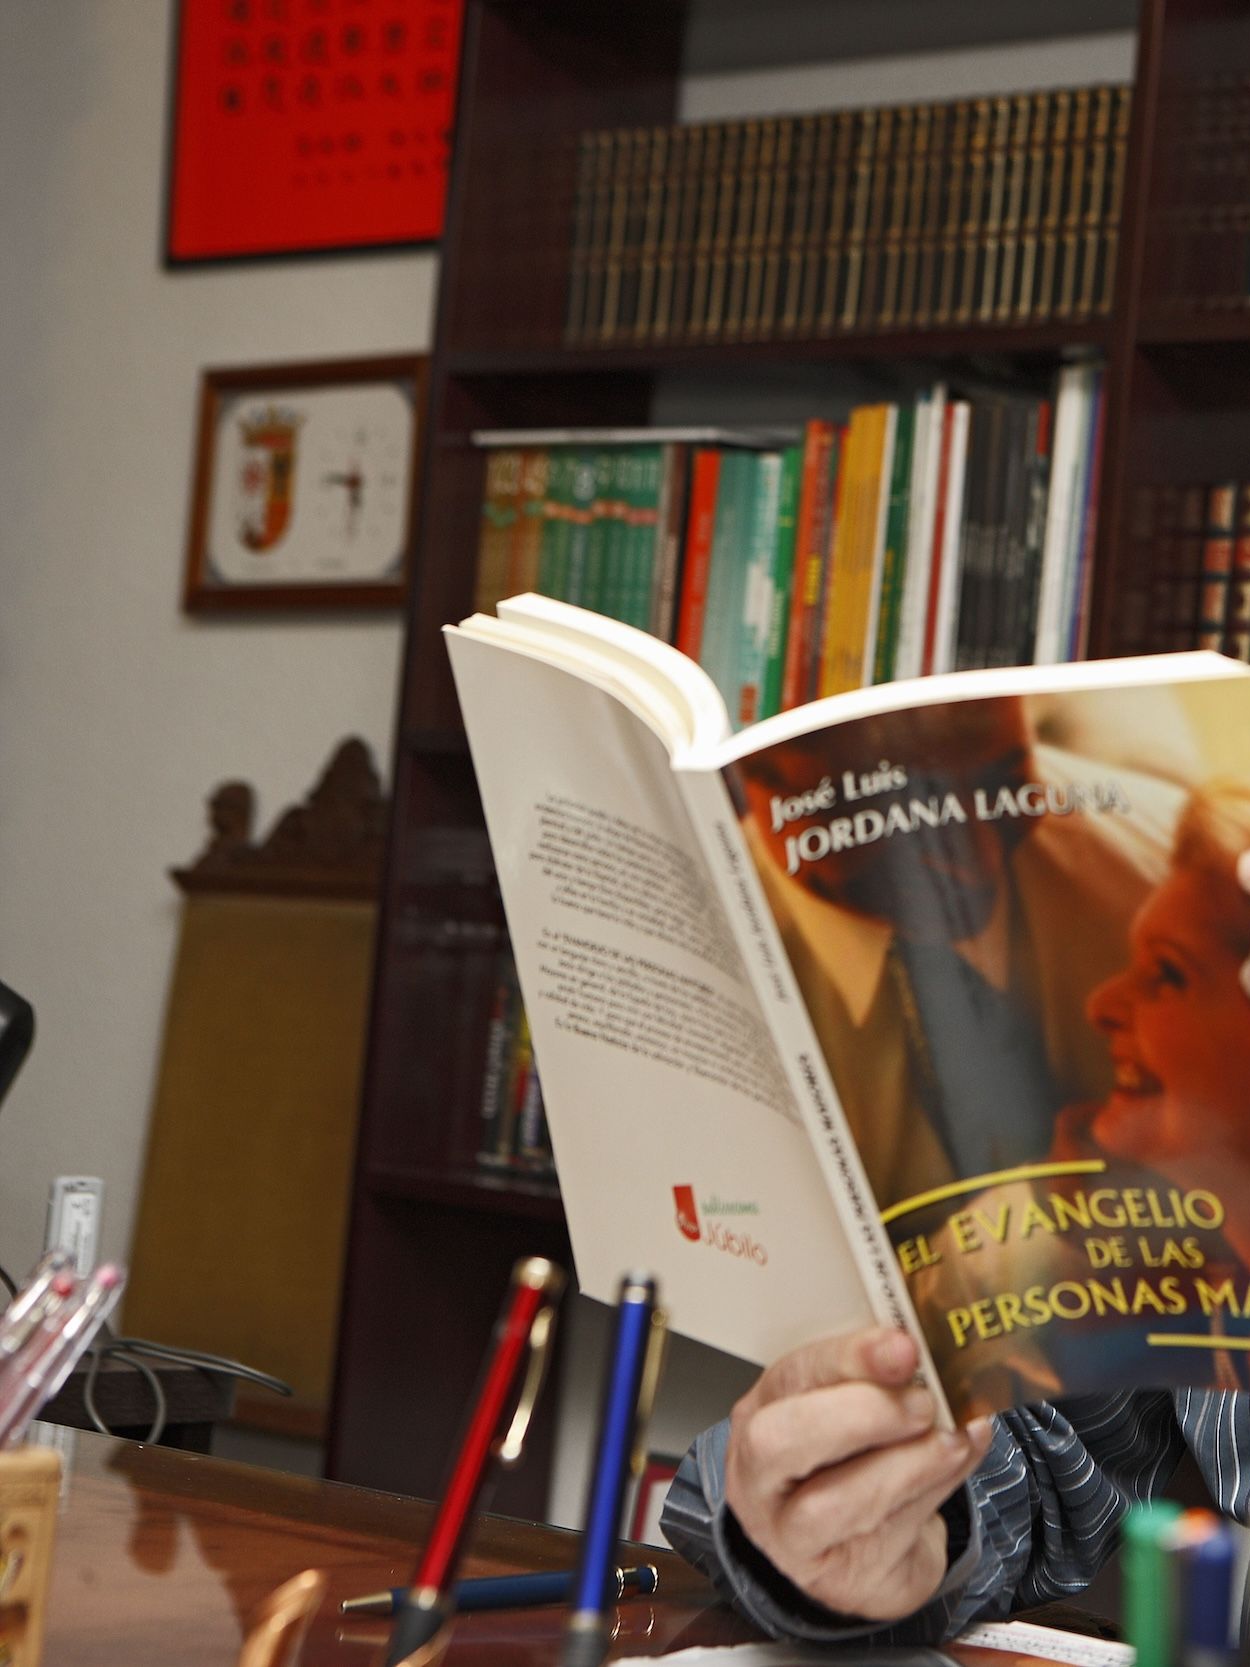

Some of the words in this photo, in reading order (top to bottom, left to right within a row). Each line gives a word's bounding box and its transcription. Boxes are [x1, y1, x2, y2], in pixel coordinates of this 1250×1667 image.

[769, 776, 837, 833] José
[842, 759, 908, 801] Luis
[784, 792, 967, 875] JORDANA
[898, 1240, 942, 1274] EL
[949, 1188, 1225, 1251] EVANGELIO
[1085, 1238, 1130, 1269] DE
[1144, 1236, 1205, 1269] LAS
[946, 1276, 1187, 1348] PERSONAS
